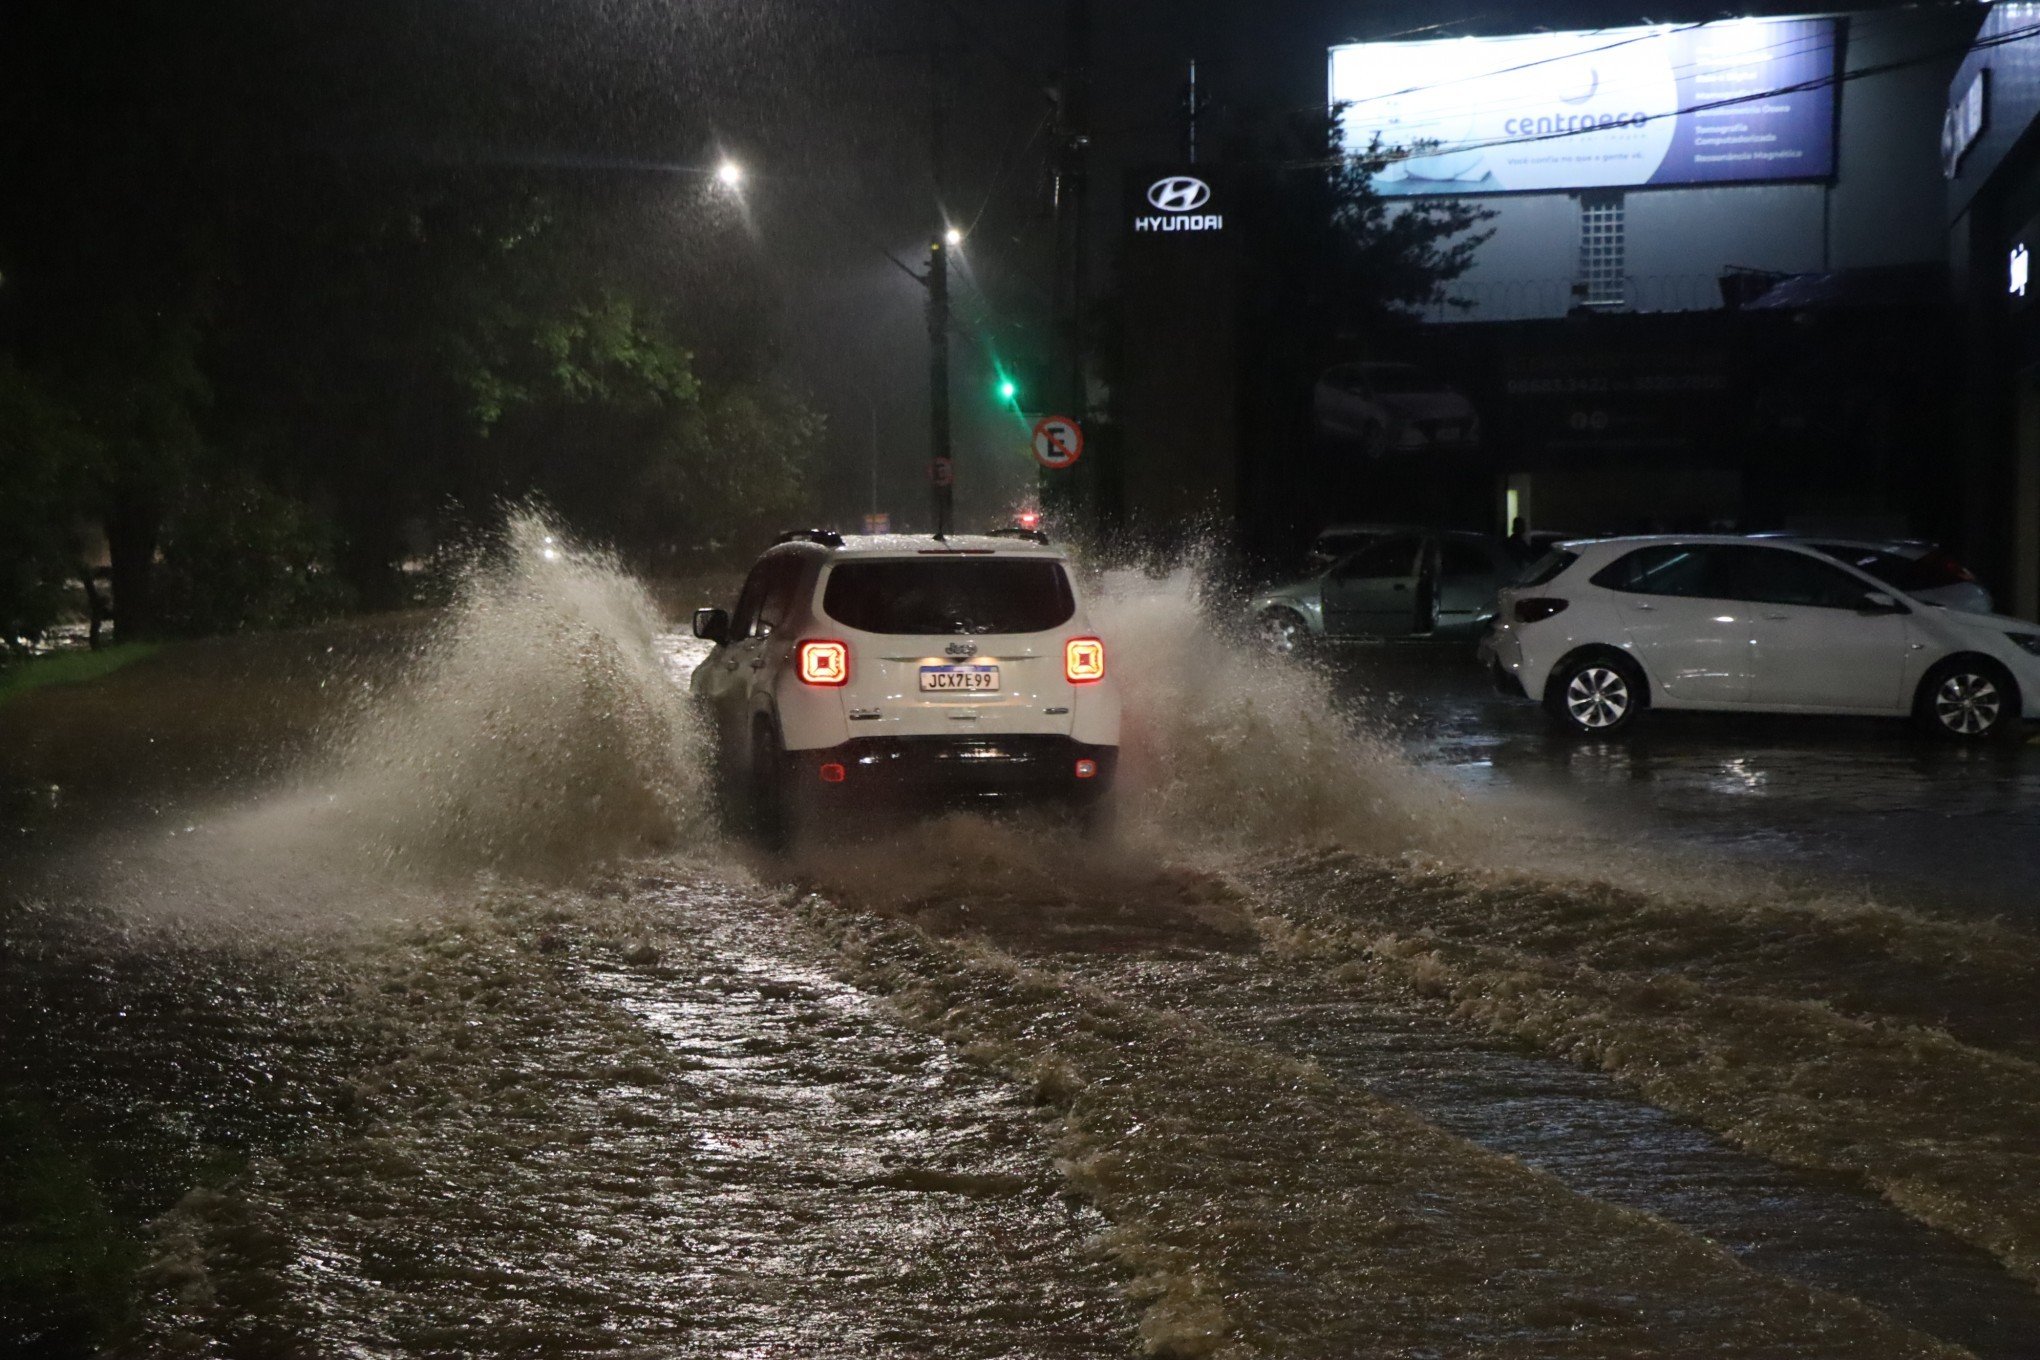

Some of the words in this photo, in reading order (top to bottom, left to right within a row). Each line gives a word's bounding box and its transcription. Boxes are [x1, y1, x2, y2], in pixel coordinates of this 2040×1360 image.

[1504, 111, 1647, 135] centroeco
[1506, 156, 1528, 165] Você
[1531, 155, 1559, 164] confia
[1135, 215, 1223, 231] HYUNDAI
[1047, 426, 1066, 458] E
[944, 642, 978, 657] Jeep
[929, 673, 991, 688] JCX7E99
